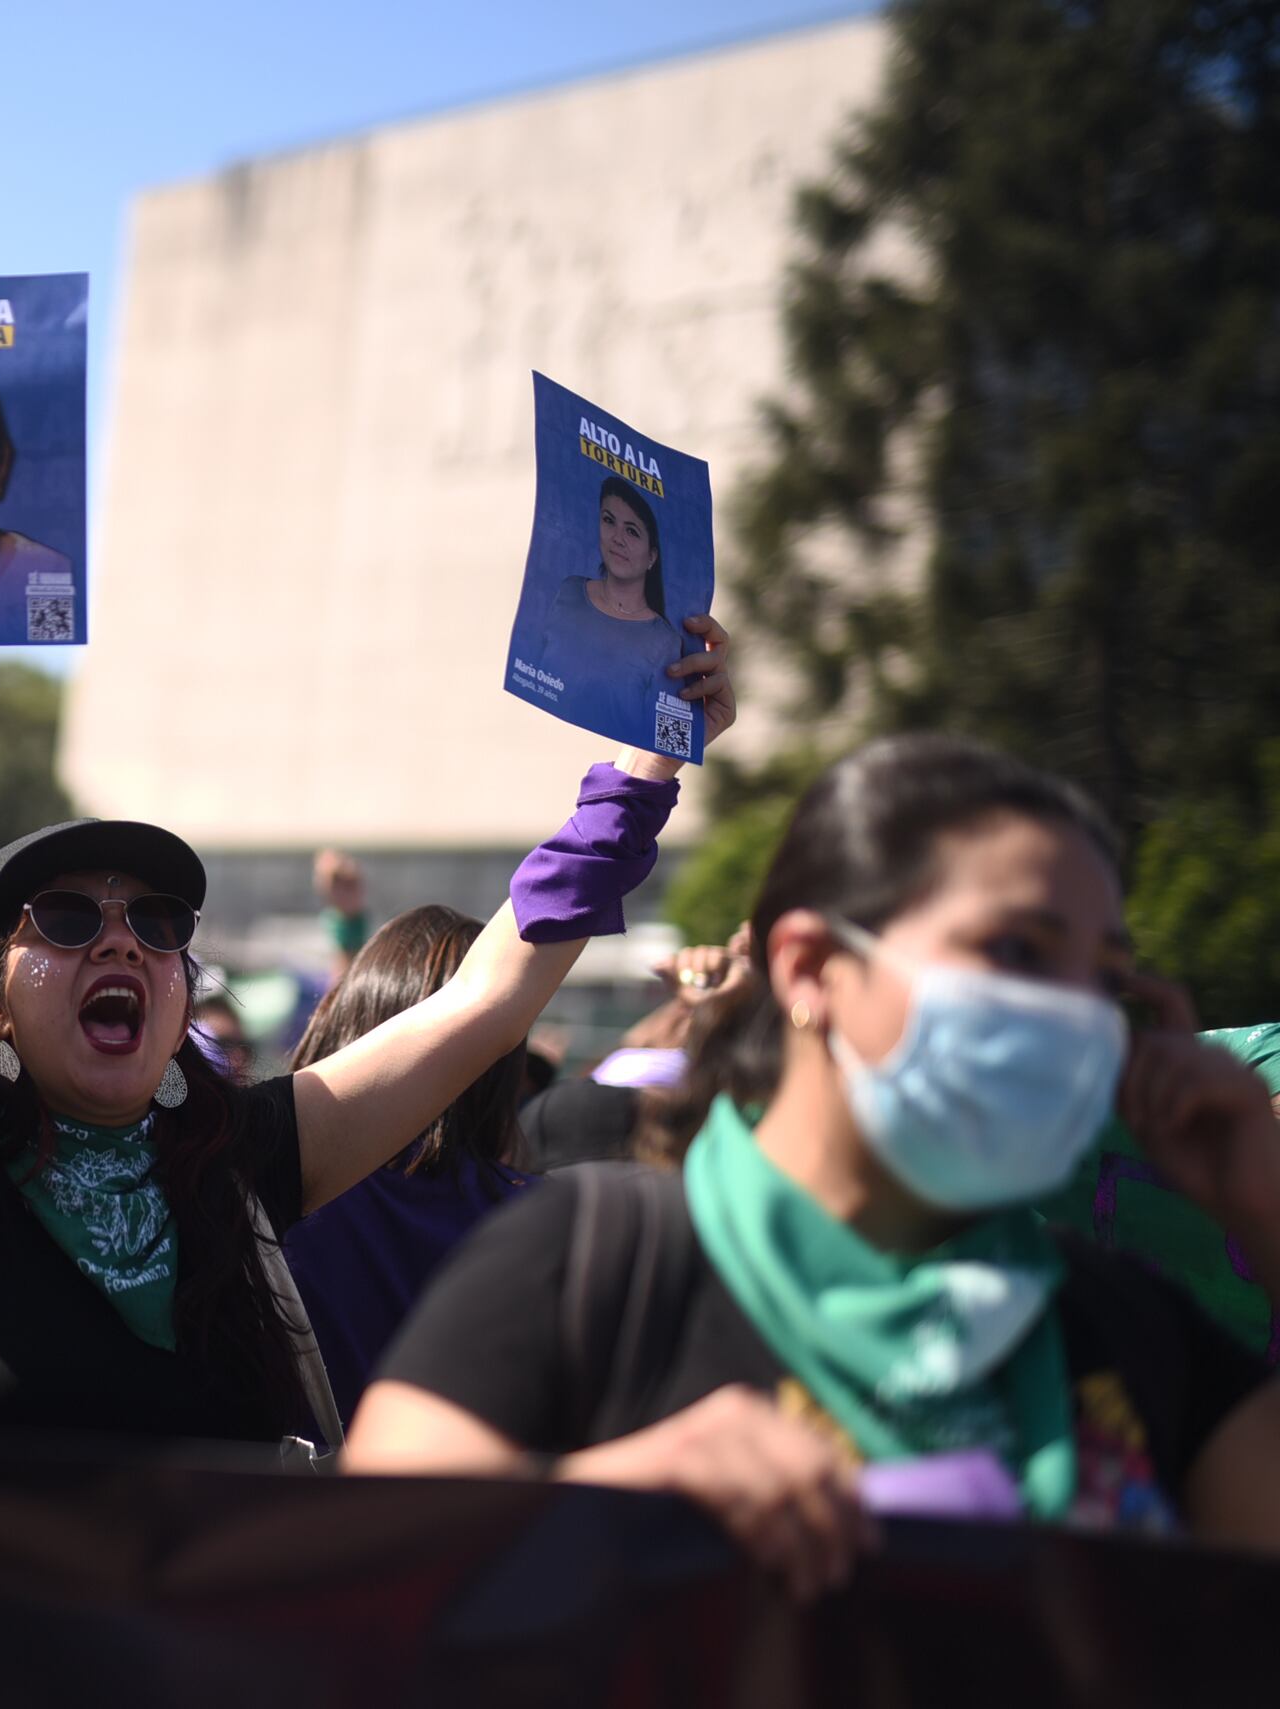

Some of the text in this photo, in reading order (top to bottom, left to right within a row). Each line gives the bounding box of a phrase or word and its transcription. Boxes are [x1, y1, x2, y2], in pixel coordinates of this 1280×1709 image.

[579, 416, 662, 480] ALTO A LA
[583, 438, 661, 495] TORTURA
[537, 669, 565, 692] Oviedo
